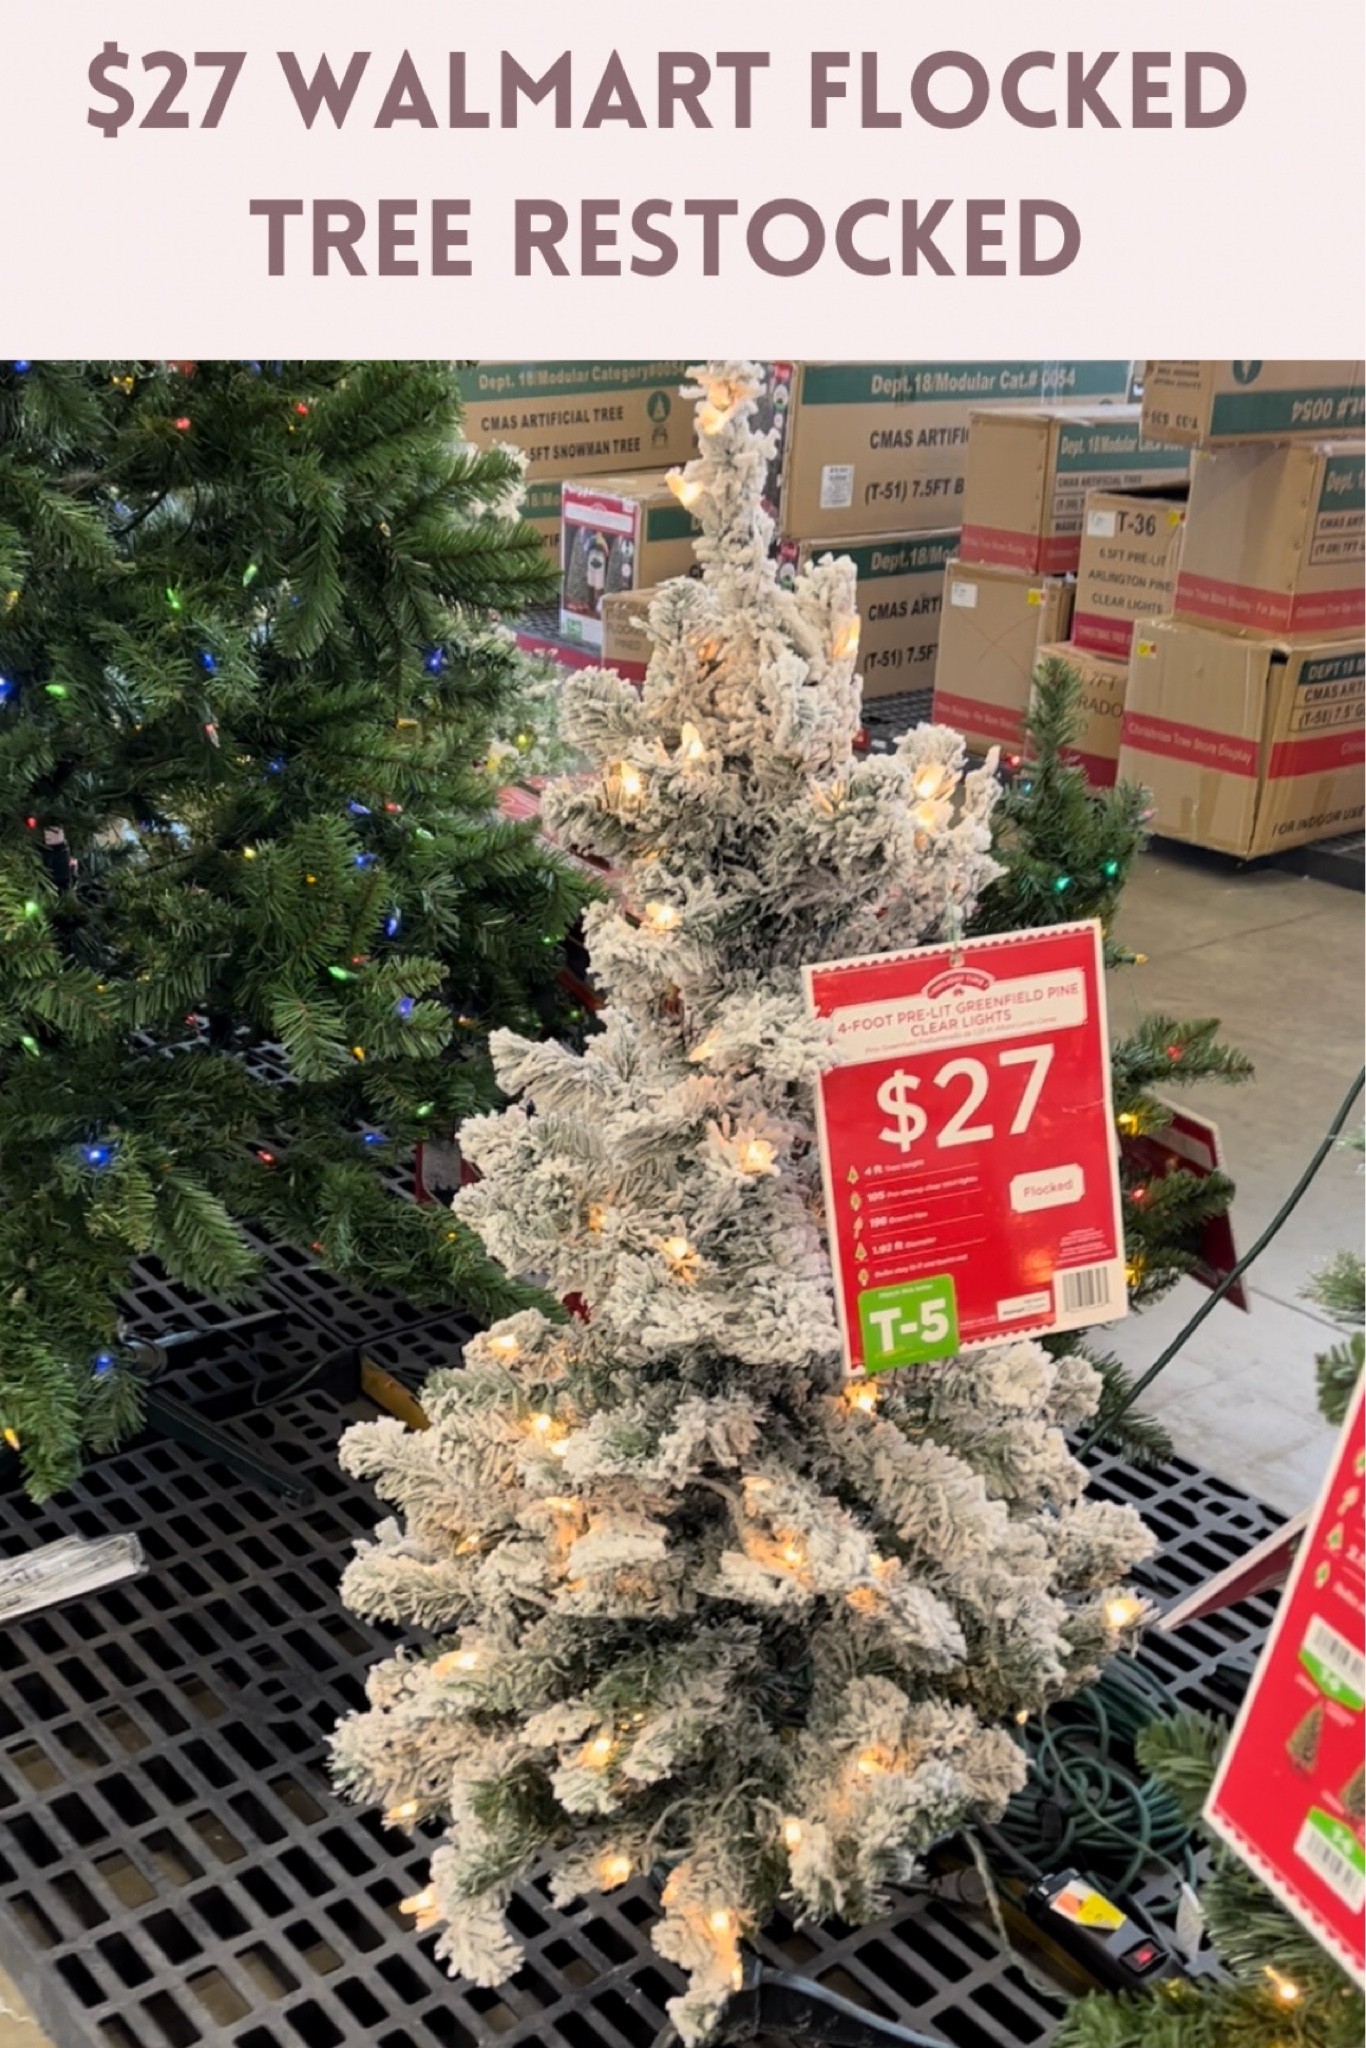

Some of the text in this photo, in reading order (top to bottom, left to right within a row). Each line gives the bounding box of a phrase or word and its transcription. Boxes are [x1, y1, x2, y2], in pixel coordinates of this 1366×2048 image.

[479, 374, 515, 391] Dept.
[481, 406, 624, 431] CMAS ARTIFICIAL TREE
[554, 441, 610, 459] SNOWMAN
[613, 437, 640, 453] TREE
[870, 429, 913, 449] CMAS
[865, 482, 908, 505] (T-51)
[912, 478, 951, 497] 7.5FT
[1117, 510, 1157, 536] T-36
[868, 601, 908, 622] CMAS
[1092, 593, 1163, 615] CLEAR LIGHTS
[864, 649, 902, 673] (T-51)
[1308, 662, 1340, 681] DEPT
[1304, 685, 1337, 702] CMAS
[1128, 722, 1172, 743] Christmas
[1173, 732, 1191, 747] Tree
[1218, 743, 1252, 765] Display
[838, 982, 1079, 1034] 4-FOOT PRE-LIT GREENFIELD PINE
[910, 1020, 958, 1038] CLEAR
[962, 1008, 1012, 1028] LIGHTS
[876, 1043, 1055, 1153] $27
[1023, 1179, 1074, 1198] Flocked
[868, 1297, 950, 1353] T-5
